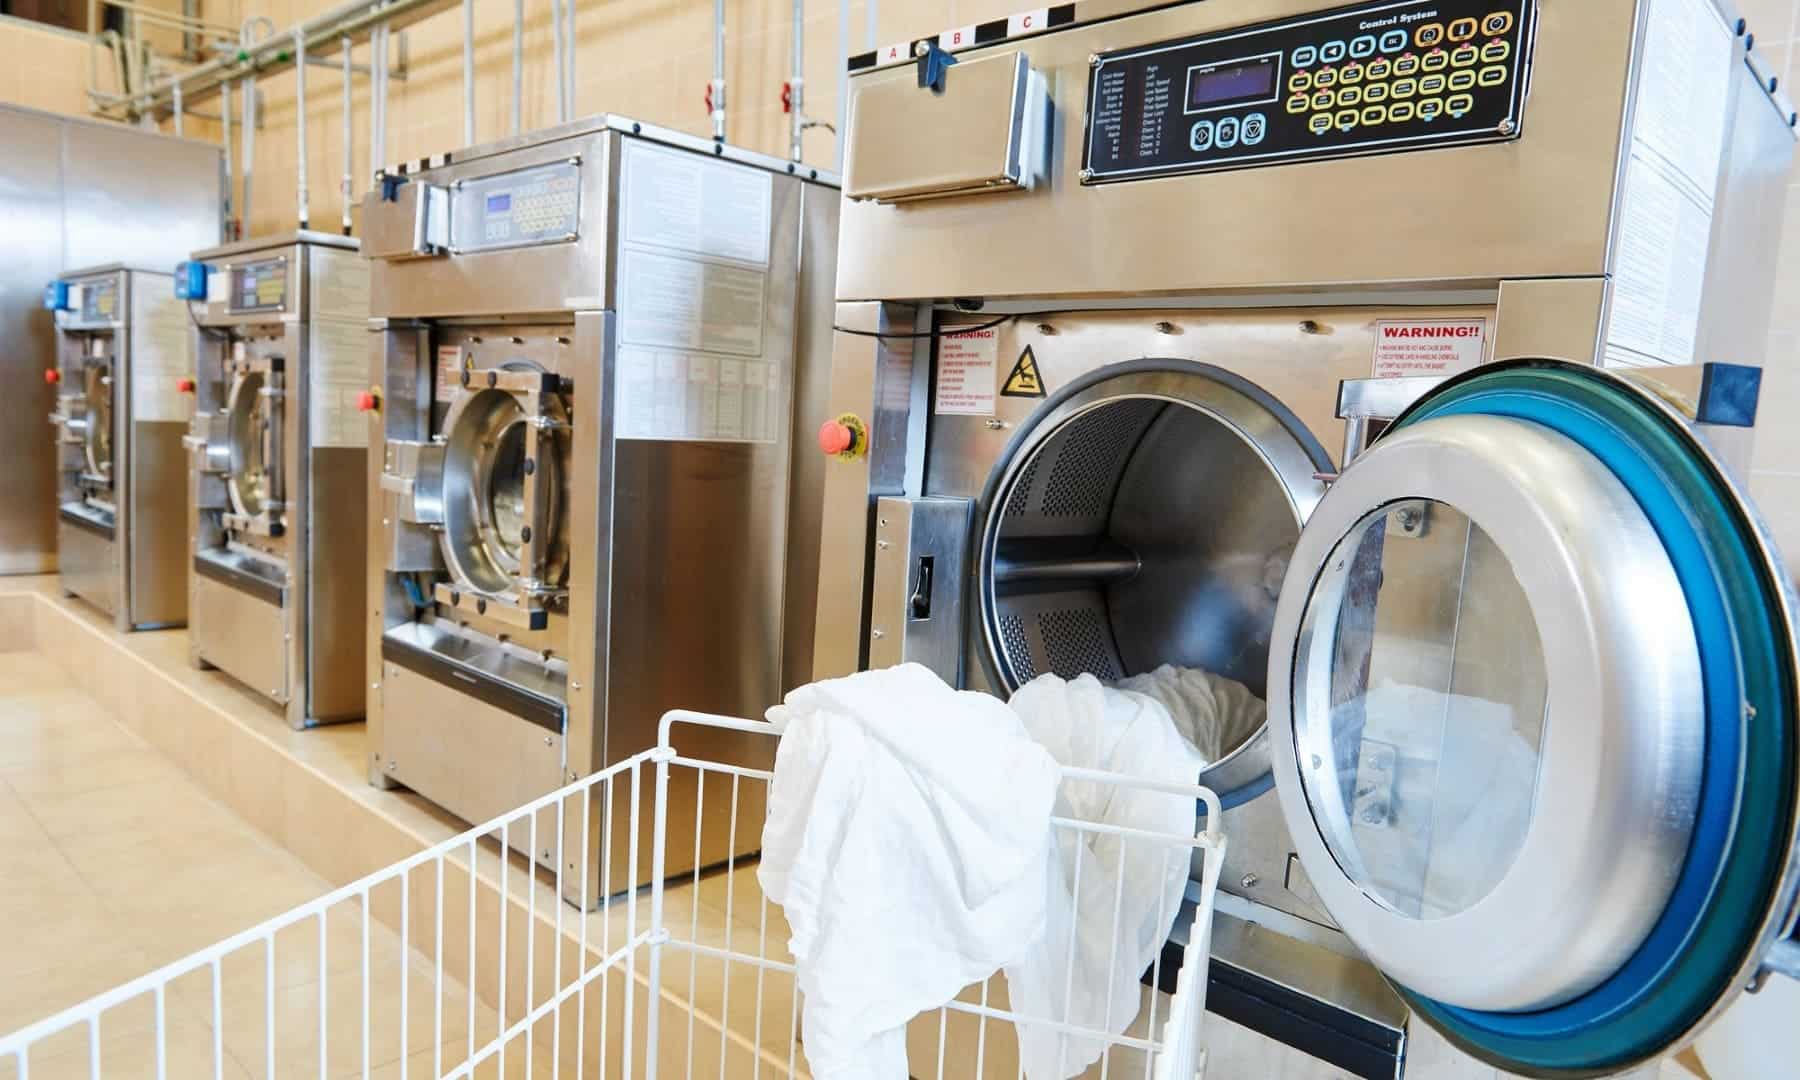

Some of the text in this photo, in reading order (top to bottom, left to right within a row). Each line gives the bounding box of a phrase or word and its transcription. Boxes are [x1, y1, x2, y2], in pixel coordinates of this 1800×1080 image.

[1023, 16, 1031, 28] C
[1360, 10, 1438, 30] Control System
[953, 32, 961, 44] B
[889, 47, 897, 59] A
[1384, 327, 1480, 337] WARNING!!
